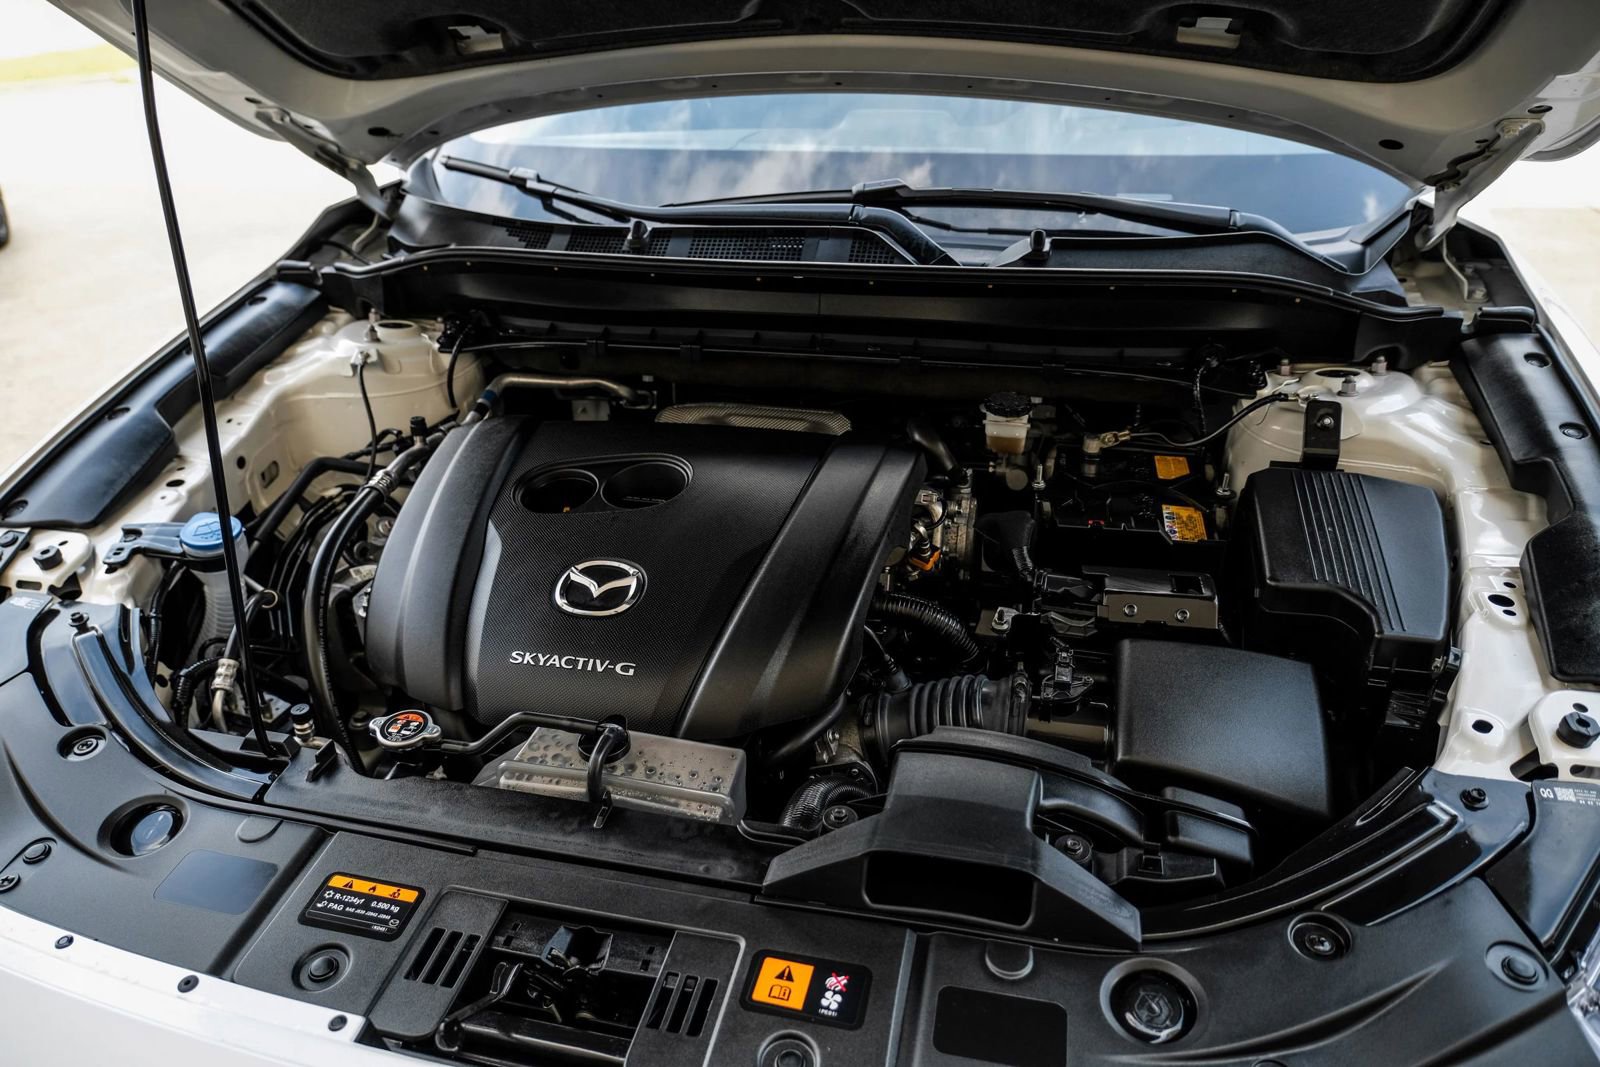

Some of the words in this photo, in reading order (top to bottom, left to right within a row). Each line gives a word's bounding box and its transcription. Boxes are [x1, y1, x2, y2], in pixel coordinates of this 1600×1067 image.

[509, 650, 636, 676] SKYACTIV-G
[327, 902, 344, 910] PAG
[334, 894, 365, 905] R-1234yf
[371, 901, 390, 910] 0.500
[390, 904, 400, 913] kg
